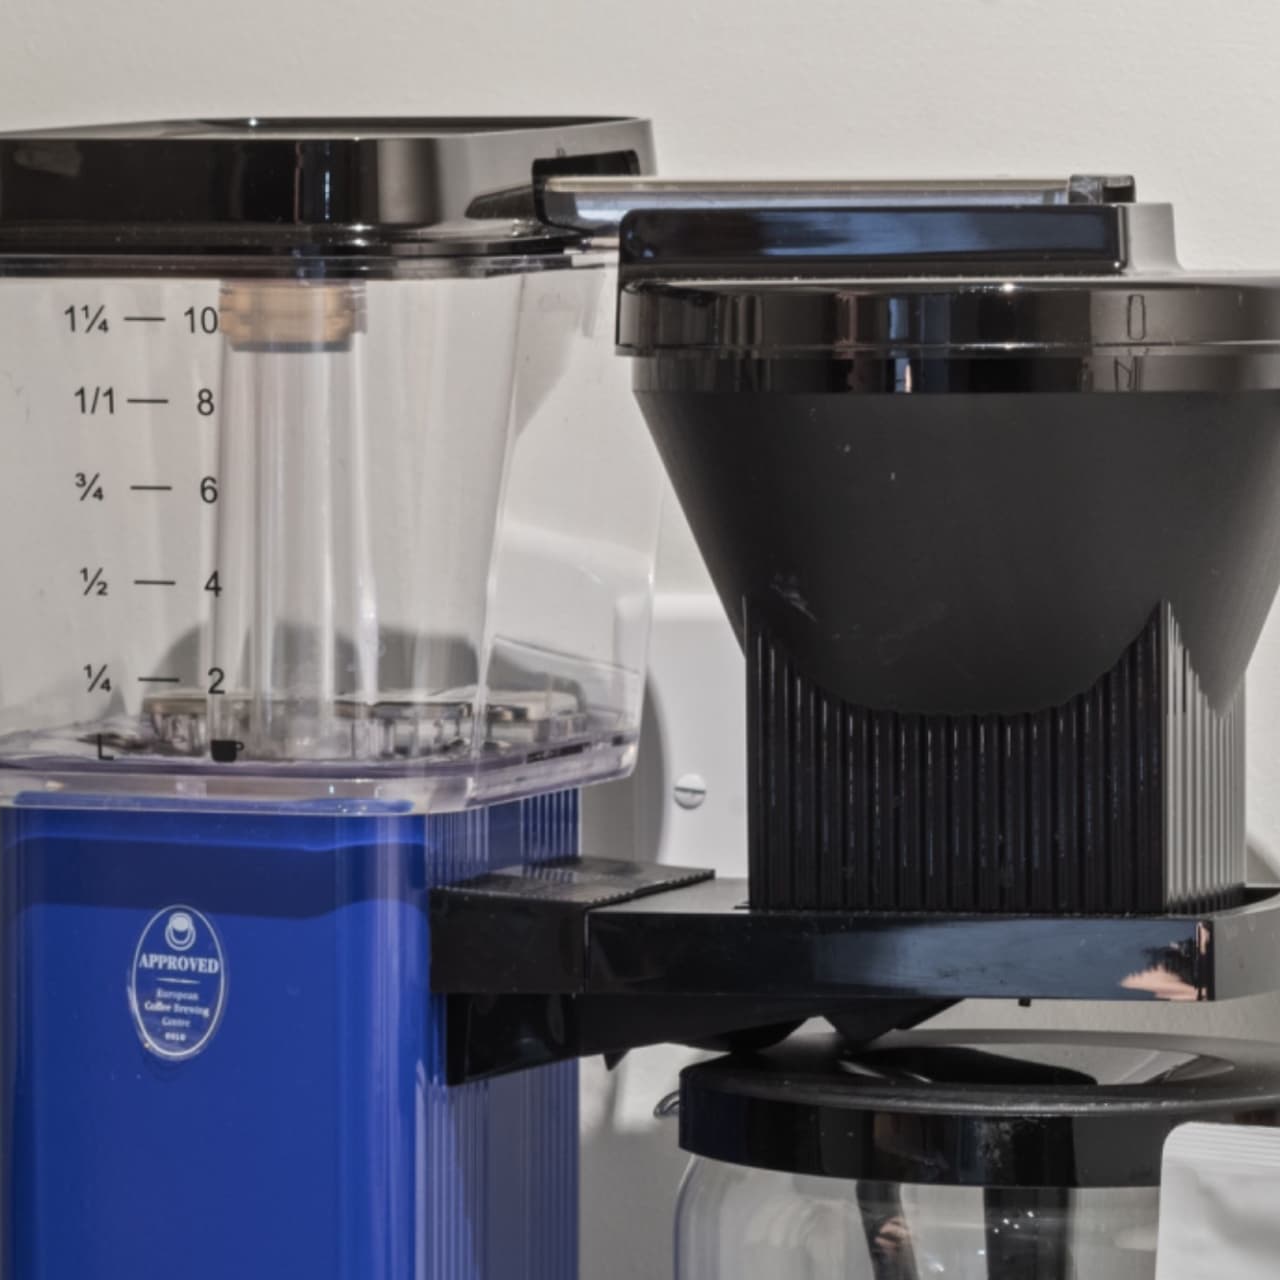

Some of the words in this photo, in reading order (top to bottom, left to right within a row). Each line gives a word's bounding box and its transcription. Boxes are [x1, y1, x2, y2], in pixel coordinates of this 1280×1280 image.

[184, 307, 218, 334] 10
[74, 387, 115, 414] 1/1
[197, 388, 214, 415] 8
[200, 477, 218, 503] 6
[205, 571, 222, 597] 4
[208, 668, 225, 694] 2
[139, 953, 219, 973] APPROVED
[145, 1001, 171, 1012] Coffee
